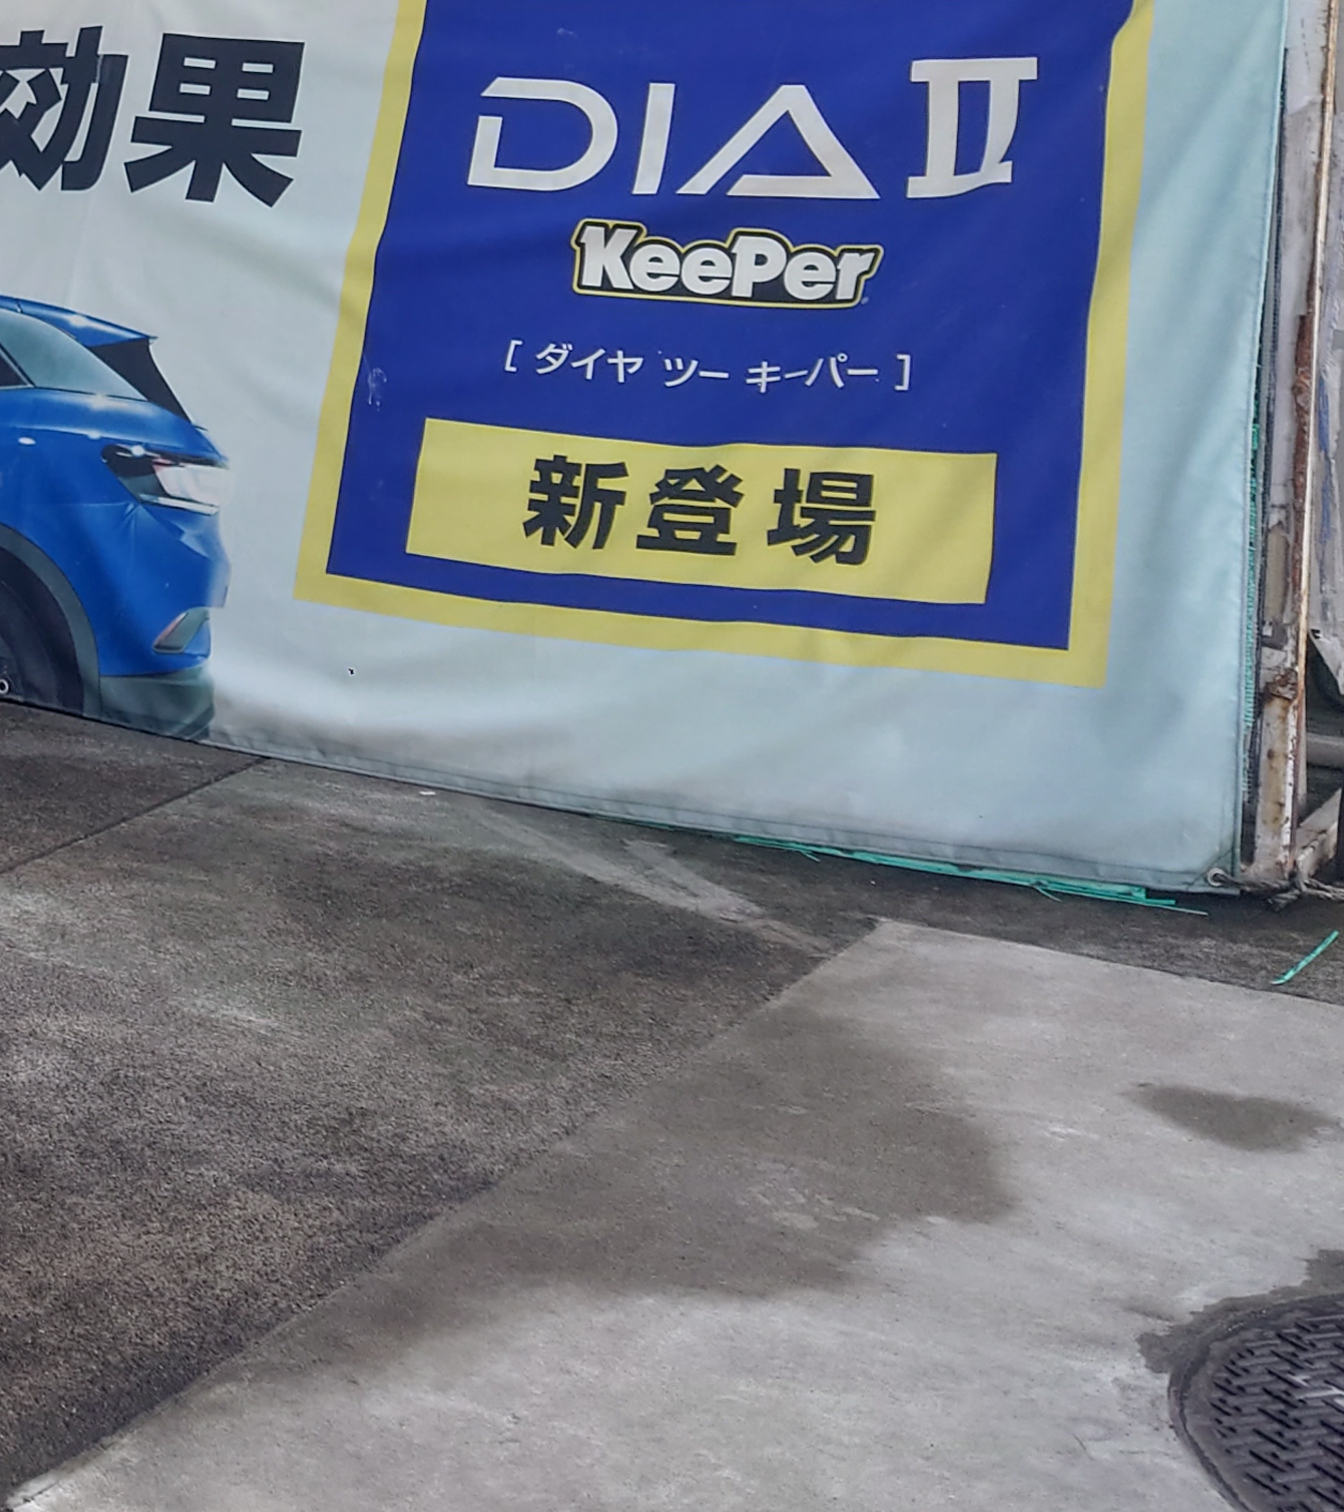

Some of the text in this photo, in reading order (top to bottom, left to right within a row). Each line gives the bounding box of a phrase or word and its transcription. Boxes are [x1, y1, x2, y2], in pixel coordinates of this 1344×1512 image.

[465, 76, 880, 200] DIA
[572, 218, 883, 308] KeePer
[521, 453, 878, 567] 新登場
